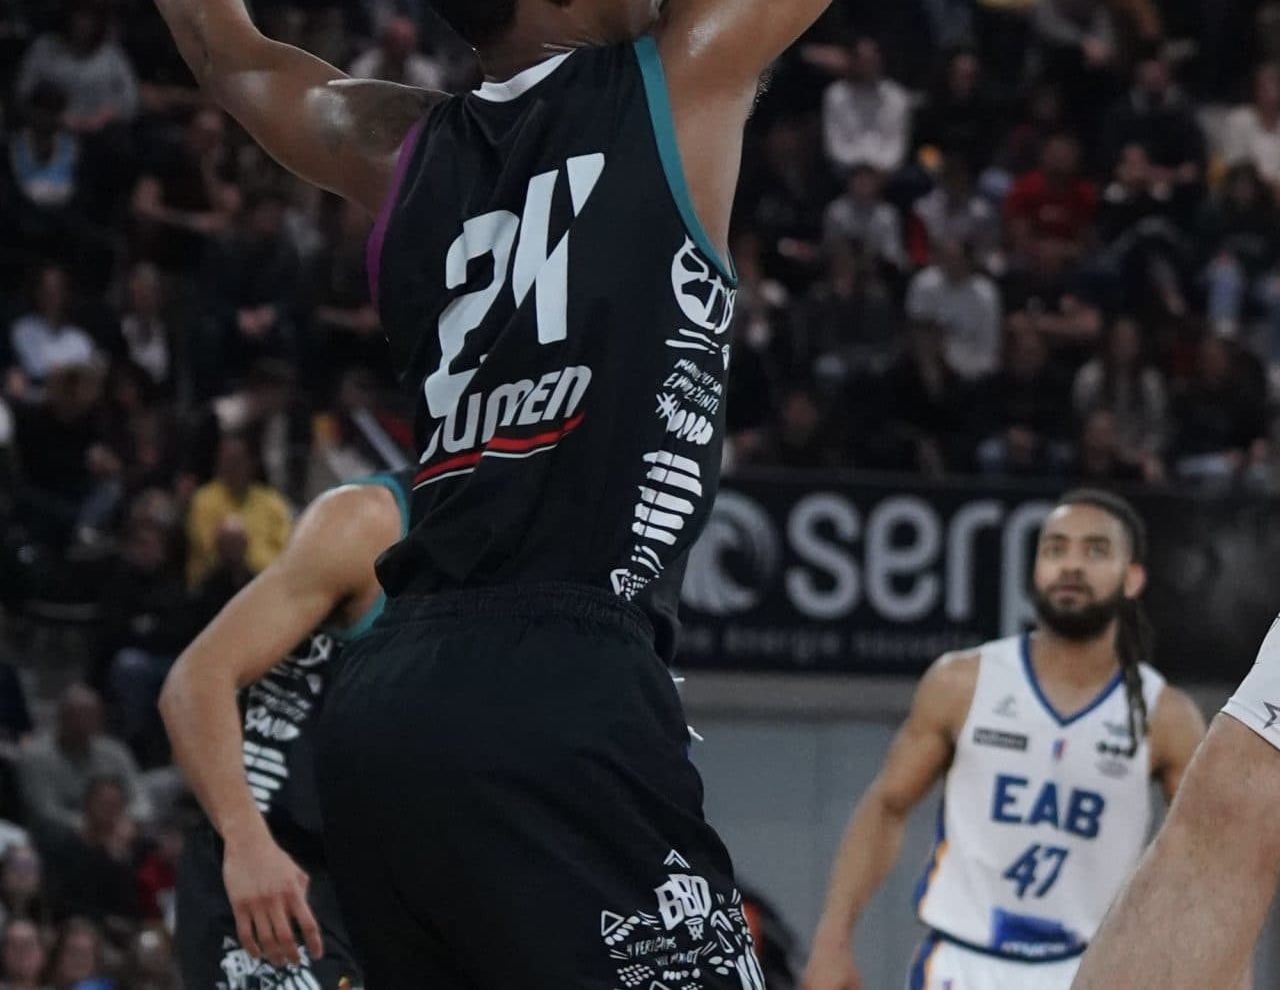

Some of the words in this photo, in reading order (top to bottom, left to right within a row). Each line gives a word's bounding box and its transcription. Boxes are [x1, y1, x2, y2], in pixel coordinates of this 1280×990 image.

[424, 152, 606, 420] 24
[991, 773, 1106, 840] EAB
[1002, 842, 1069, 900] 47
